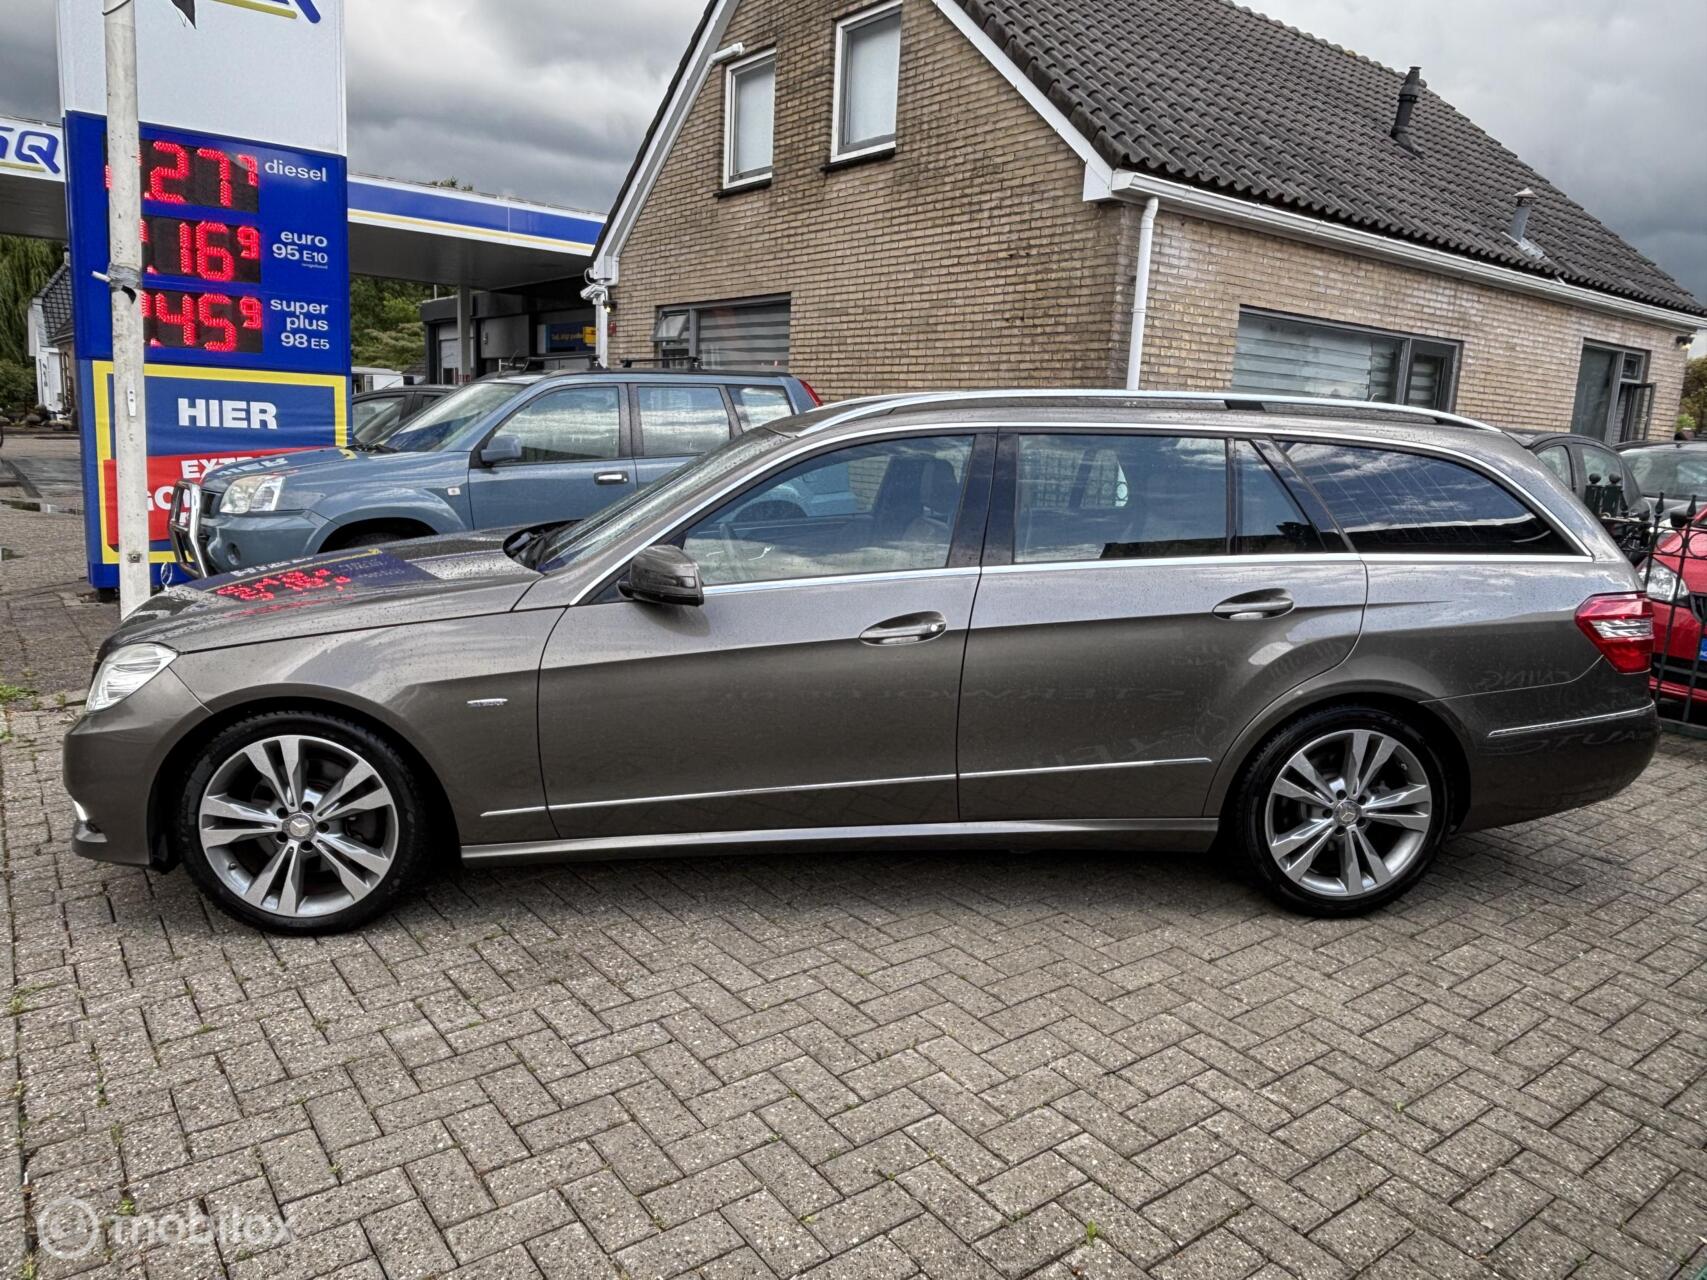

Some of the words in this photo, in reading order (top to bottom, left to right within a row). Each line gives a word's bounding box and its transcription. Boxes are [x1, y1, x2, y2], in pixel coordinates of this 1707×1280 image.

[264, 159, 327, 182] diesel
[280, 231, 328, 247] euro
[272, 243, 300, 260] 95
[303, 250, 328, 263] E10
[270, 299, 329, 316] super
[286, 314, 329, 331] plus
[280, 332, 308, 348] 98
[311, 338, 330, 349] E5
[177, 398, 278, 430] HIER
